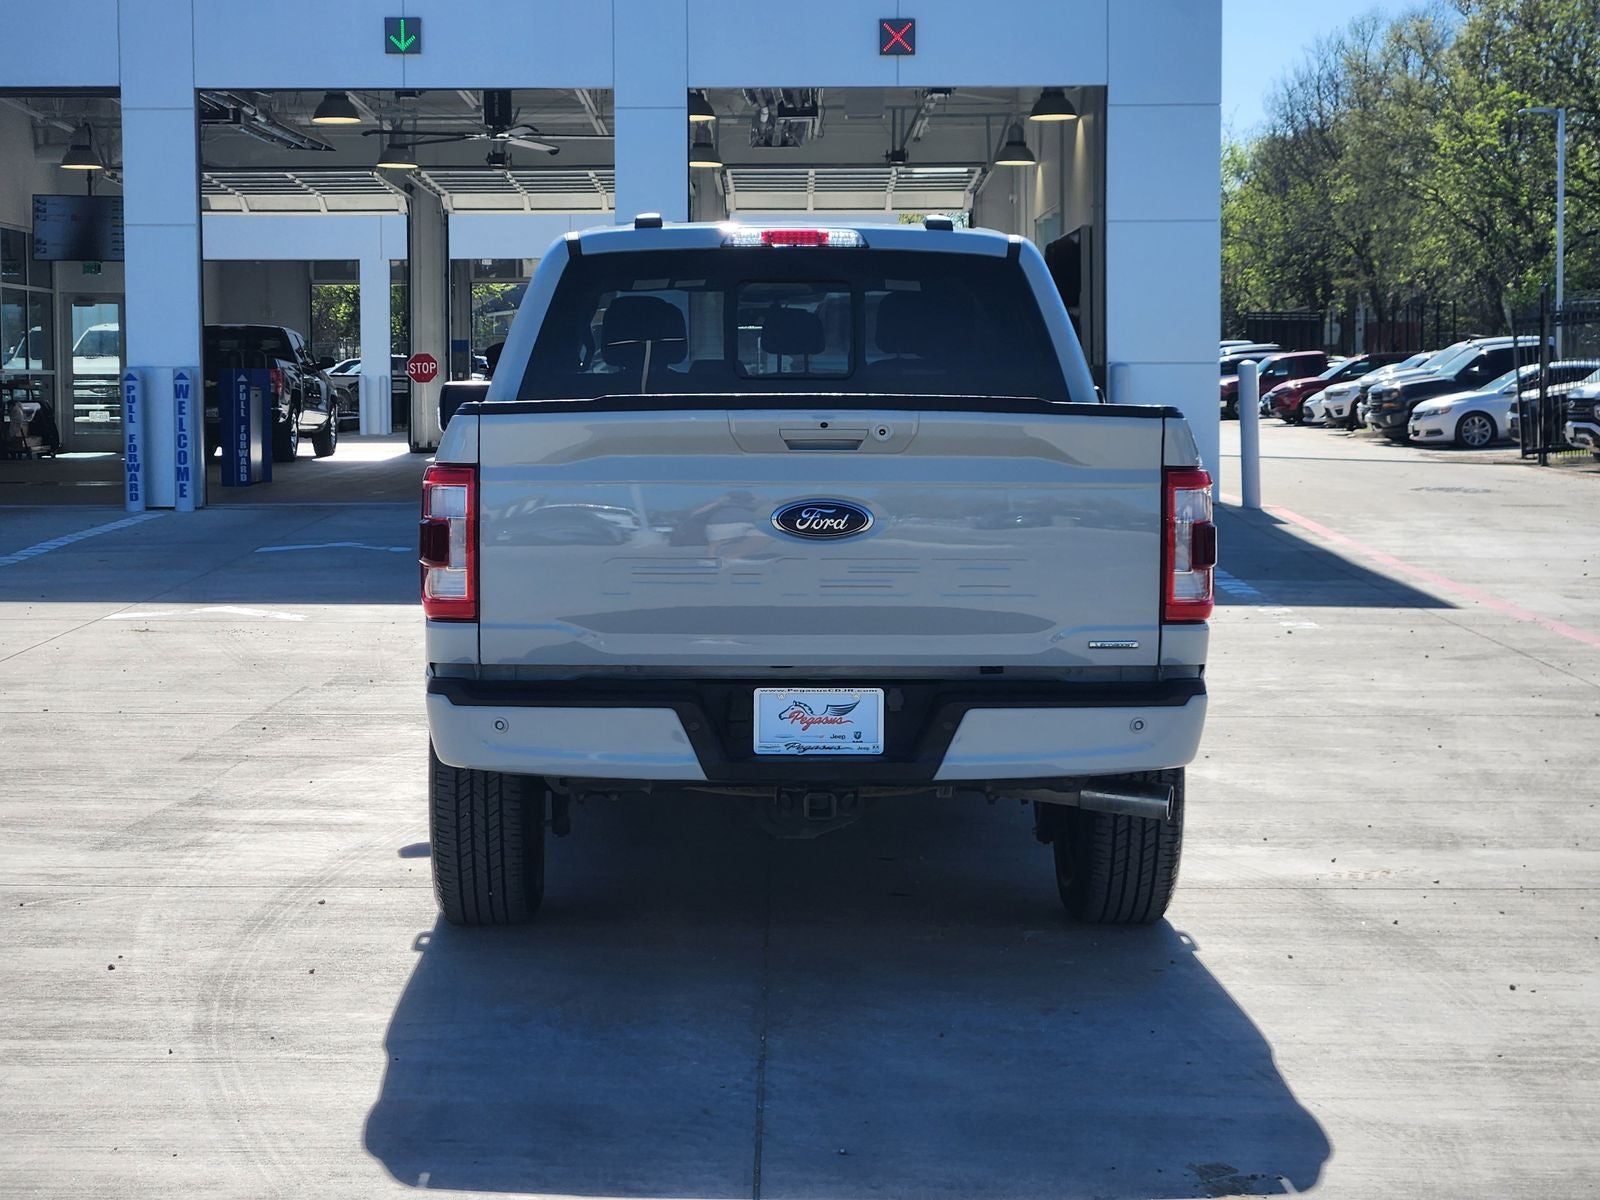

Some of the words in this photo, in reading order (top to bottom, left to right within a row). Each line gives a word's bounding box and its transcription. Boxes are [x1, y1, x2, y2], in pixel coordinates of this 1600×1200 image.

[410, 362, 436, 374] STOP
[126, 384, 136, 424] PULL
[174, 384, 190, 498] WELCOME
[238, 425, 248, 482] FORWARD
[126, 434, 140, 502] FORWARD
[796, 507, 850, 530] Ford
[788, 710, 855, 731] Pegasus
